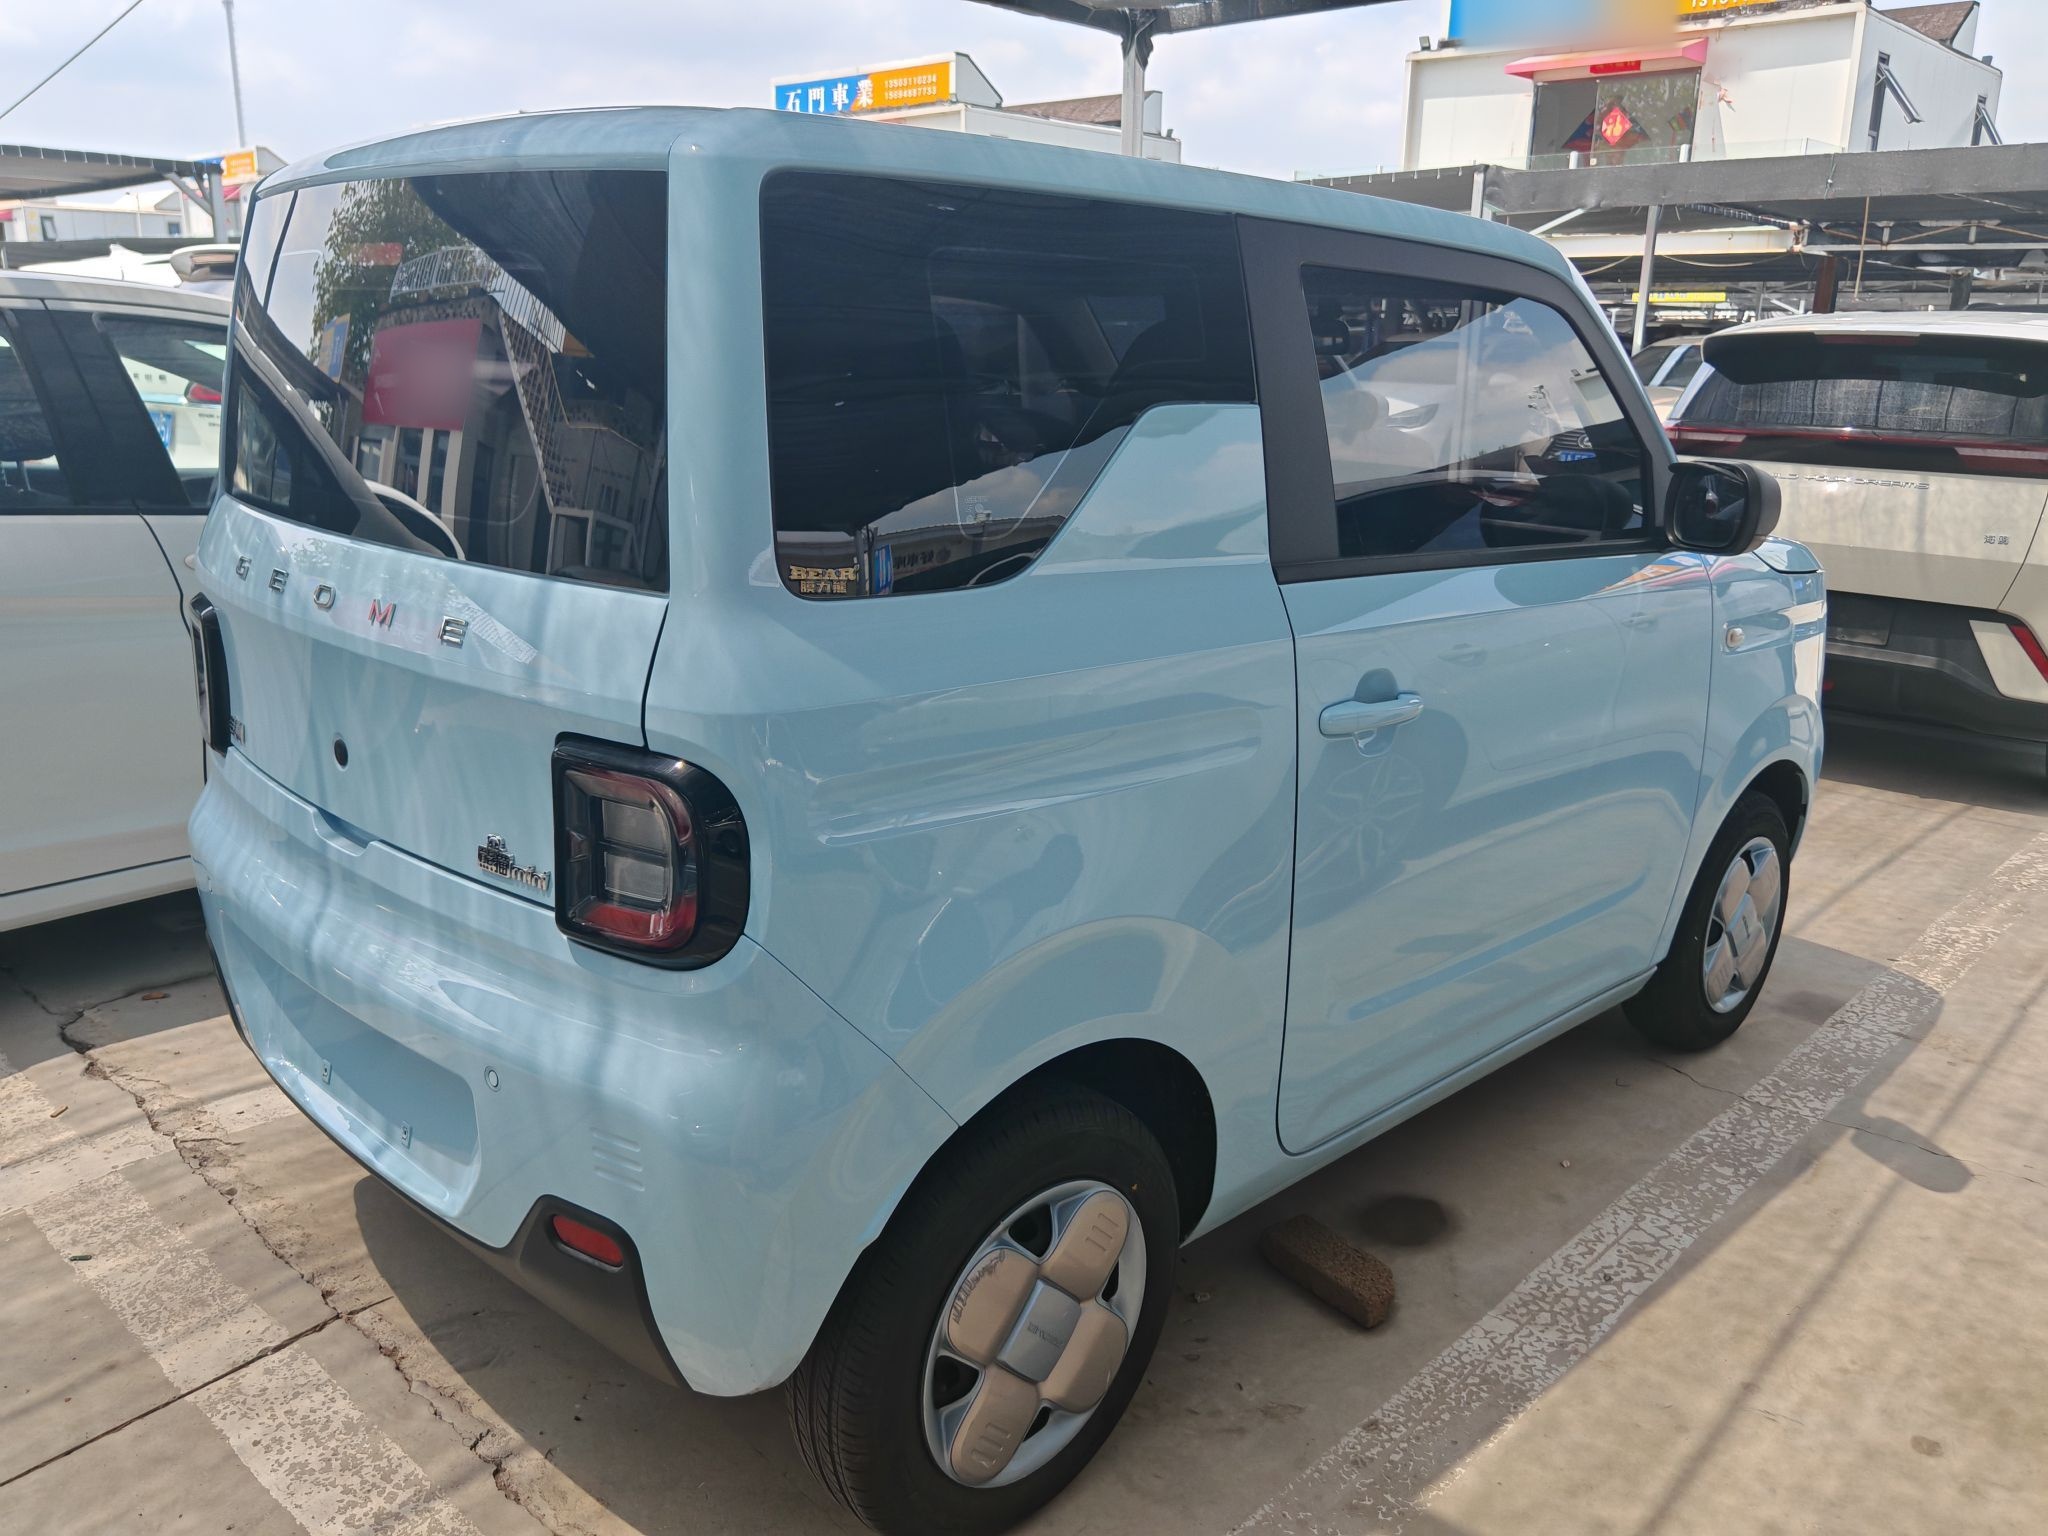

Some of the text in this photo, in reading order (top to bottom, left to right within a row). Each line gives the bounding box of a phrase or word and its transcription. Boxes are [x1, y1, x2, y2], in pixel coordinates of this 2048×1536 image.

[785, 79, 873, 112] 石門車業
[789, 565, 857, 581] BEAR
[235, 554, 469, 648] GEOME
